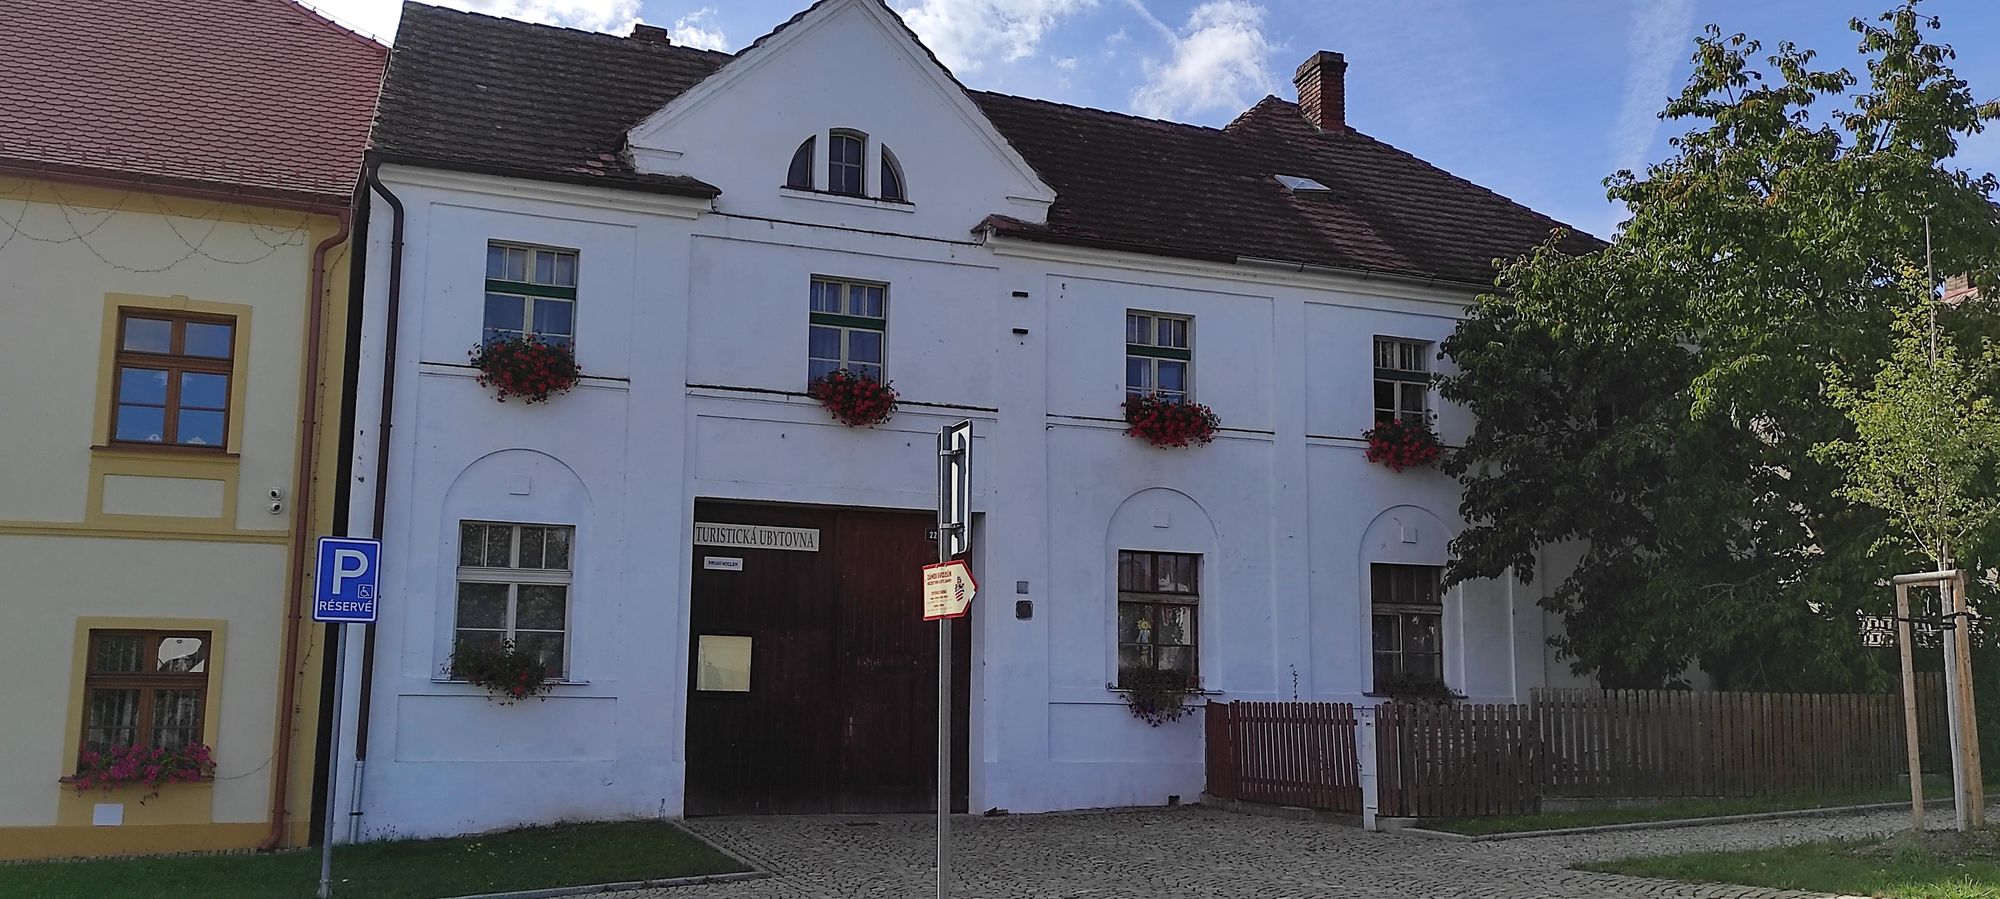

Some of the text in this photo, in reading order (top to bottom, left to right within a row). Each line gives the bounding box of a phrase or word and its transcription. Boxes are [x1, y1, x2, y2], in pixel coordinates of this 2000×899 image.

[696, 526, 814, 548] TURISTICKÁ UBYTOVNA
[332, 549, 368, 595] P
[319, 599, 373, 612] RÉSERVÉ
